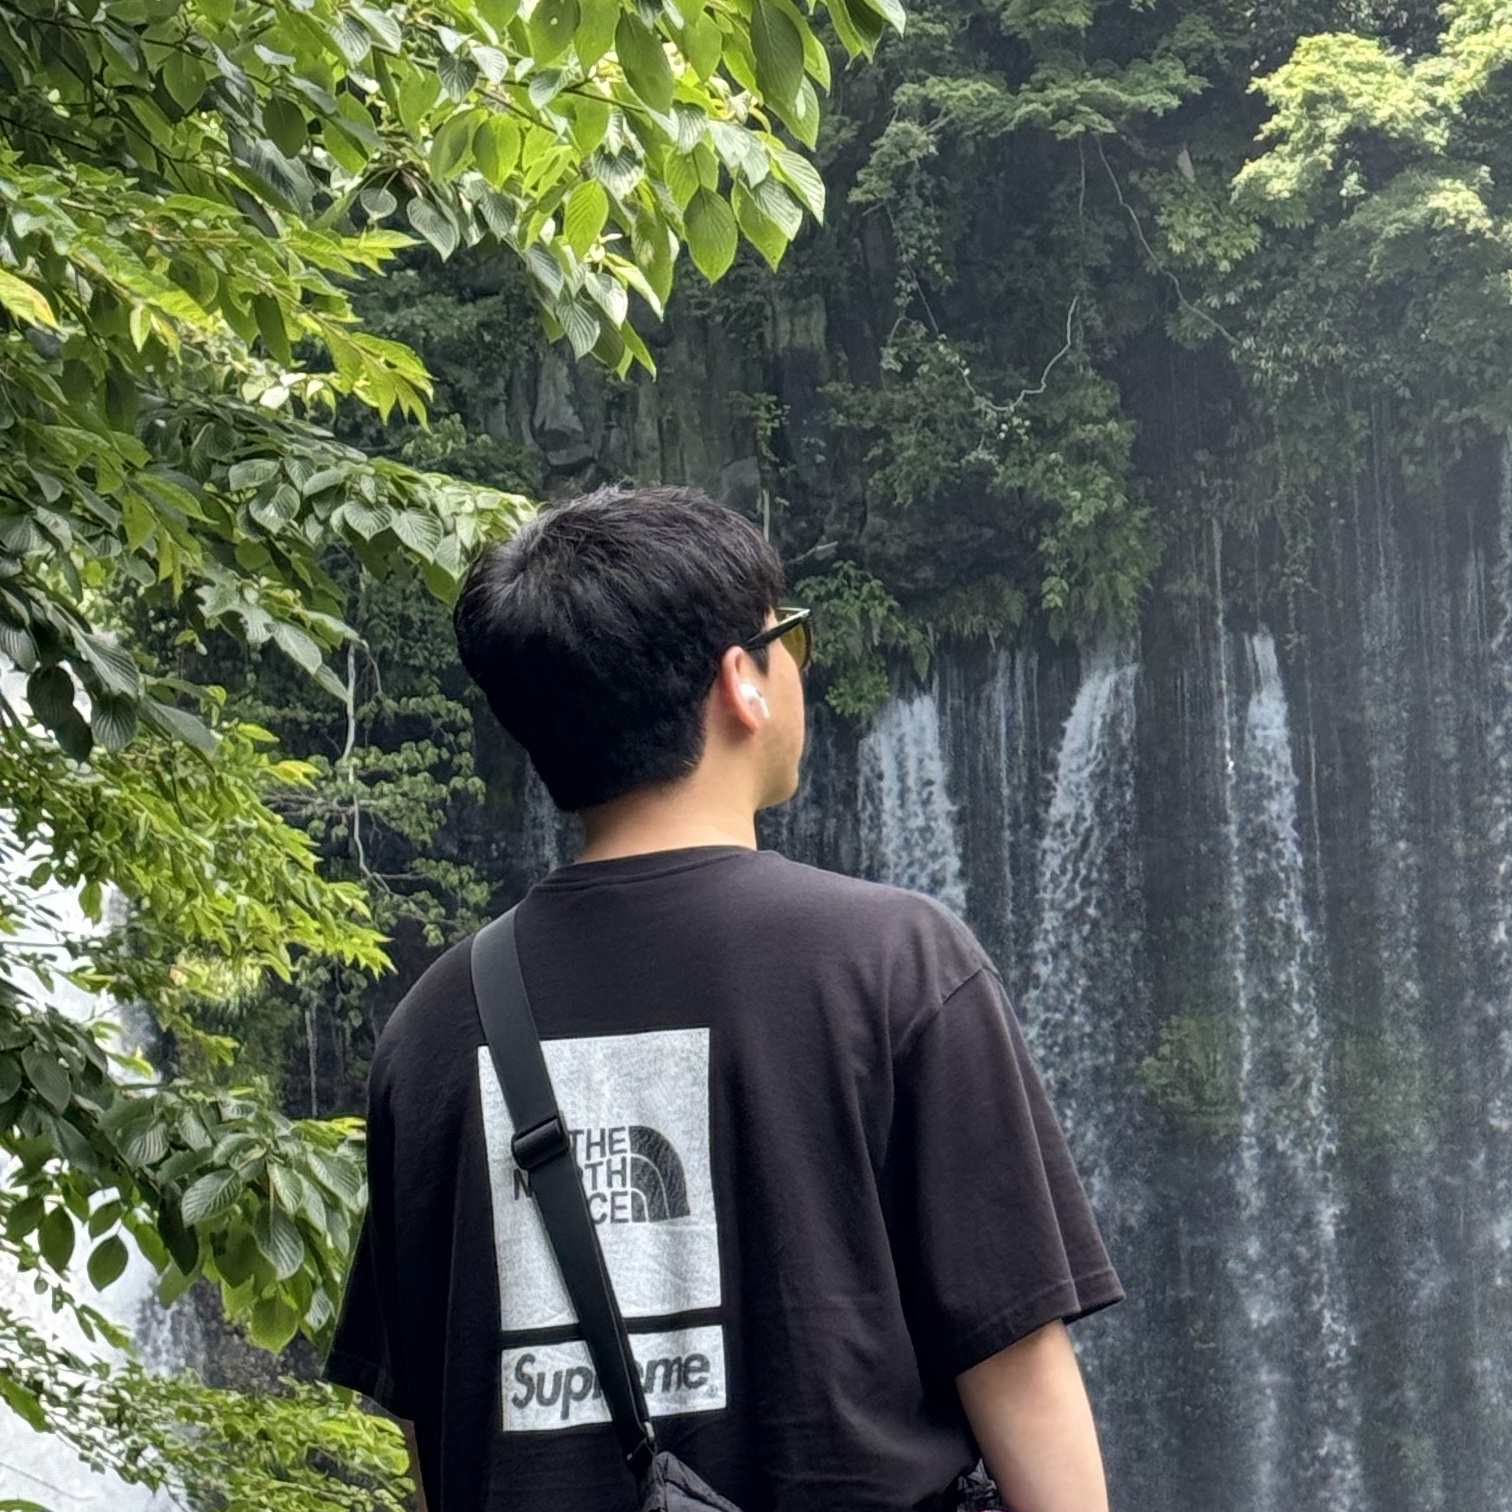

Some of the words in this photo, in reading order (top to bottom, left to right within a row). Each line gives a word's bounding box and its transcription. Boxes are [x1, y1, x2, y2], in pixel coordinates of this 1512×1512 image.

[568, 1126, 628, 1161] THE
[513, 1156, 628, 1201] NTH
[588, 1190, 630, 1225] CE
[511, 1353, 710, 1420] Supme
